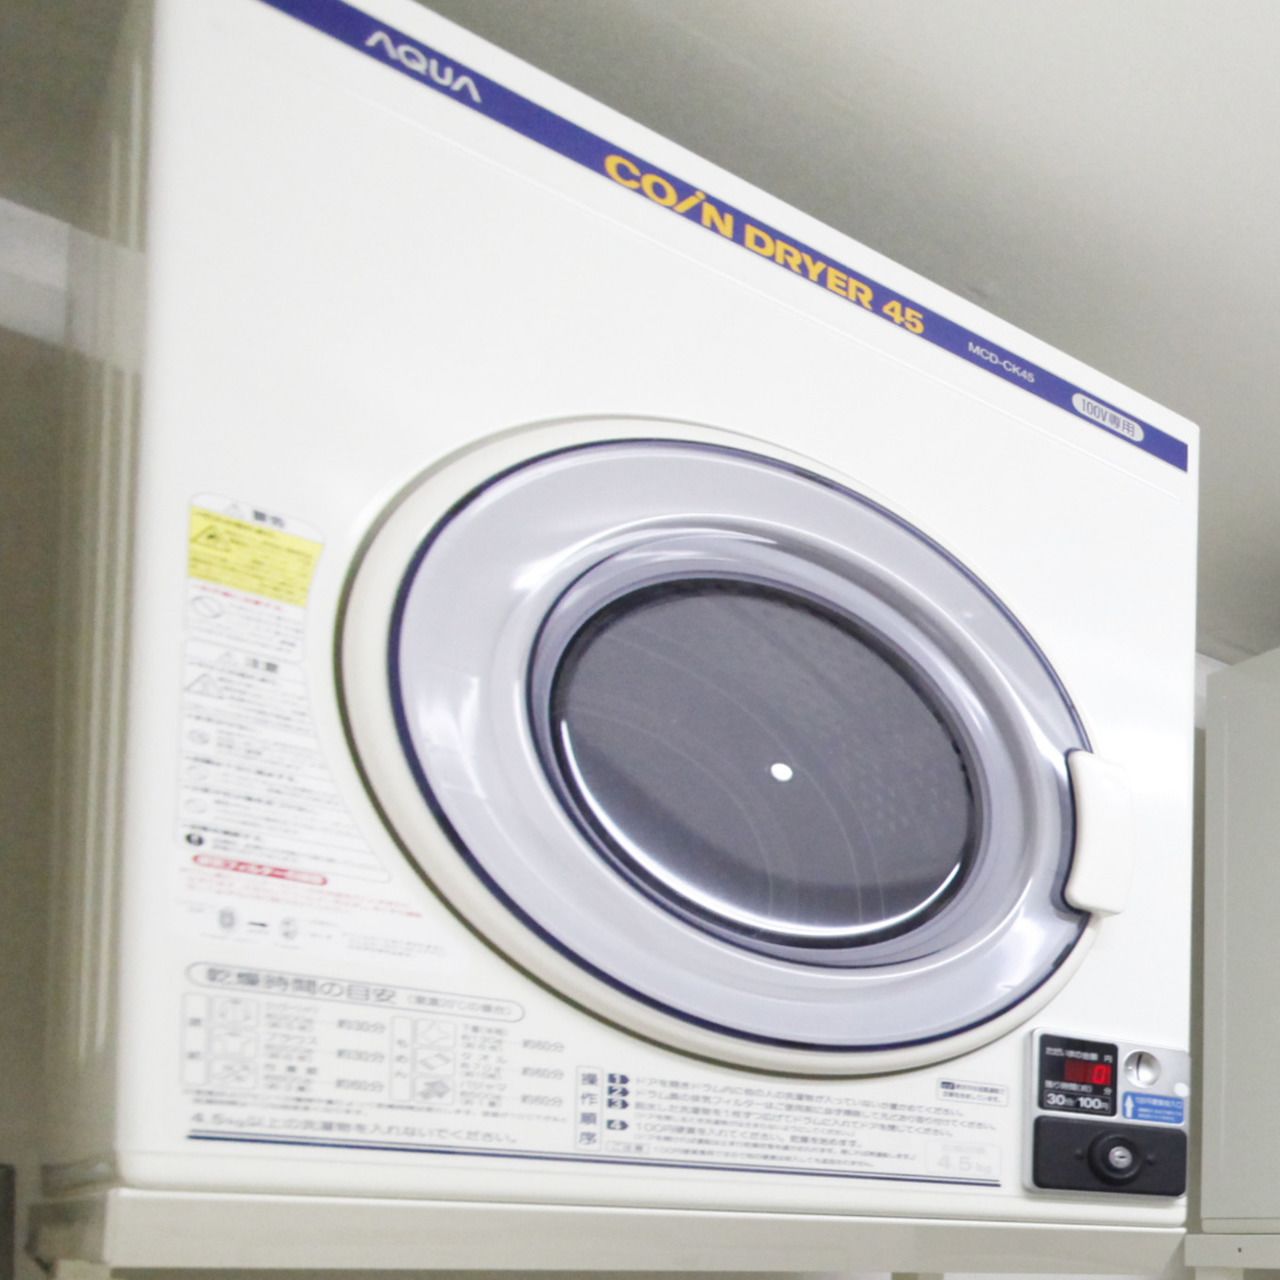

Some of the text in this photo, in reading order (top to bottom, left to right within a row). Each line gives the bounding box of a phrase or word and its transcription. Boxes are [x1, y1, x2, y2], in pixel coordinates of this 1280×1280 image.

[365, 30, 483, 103] AQUA
[744, 223, 874, 312] DRYER
[881, 299, 925, 335] 45
